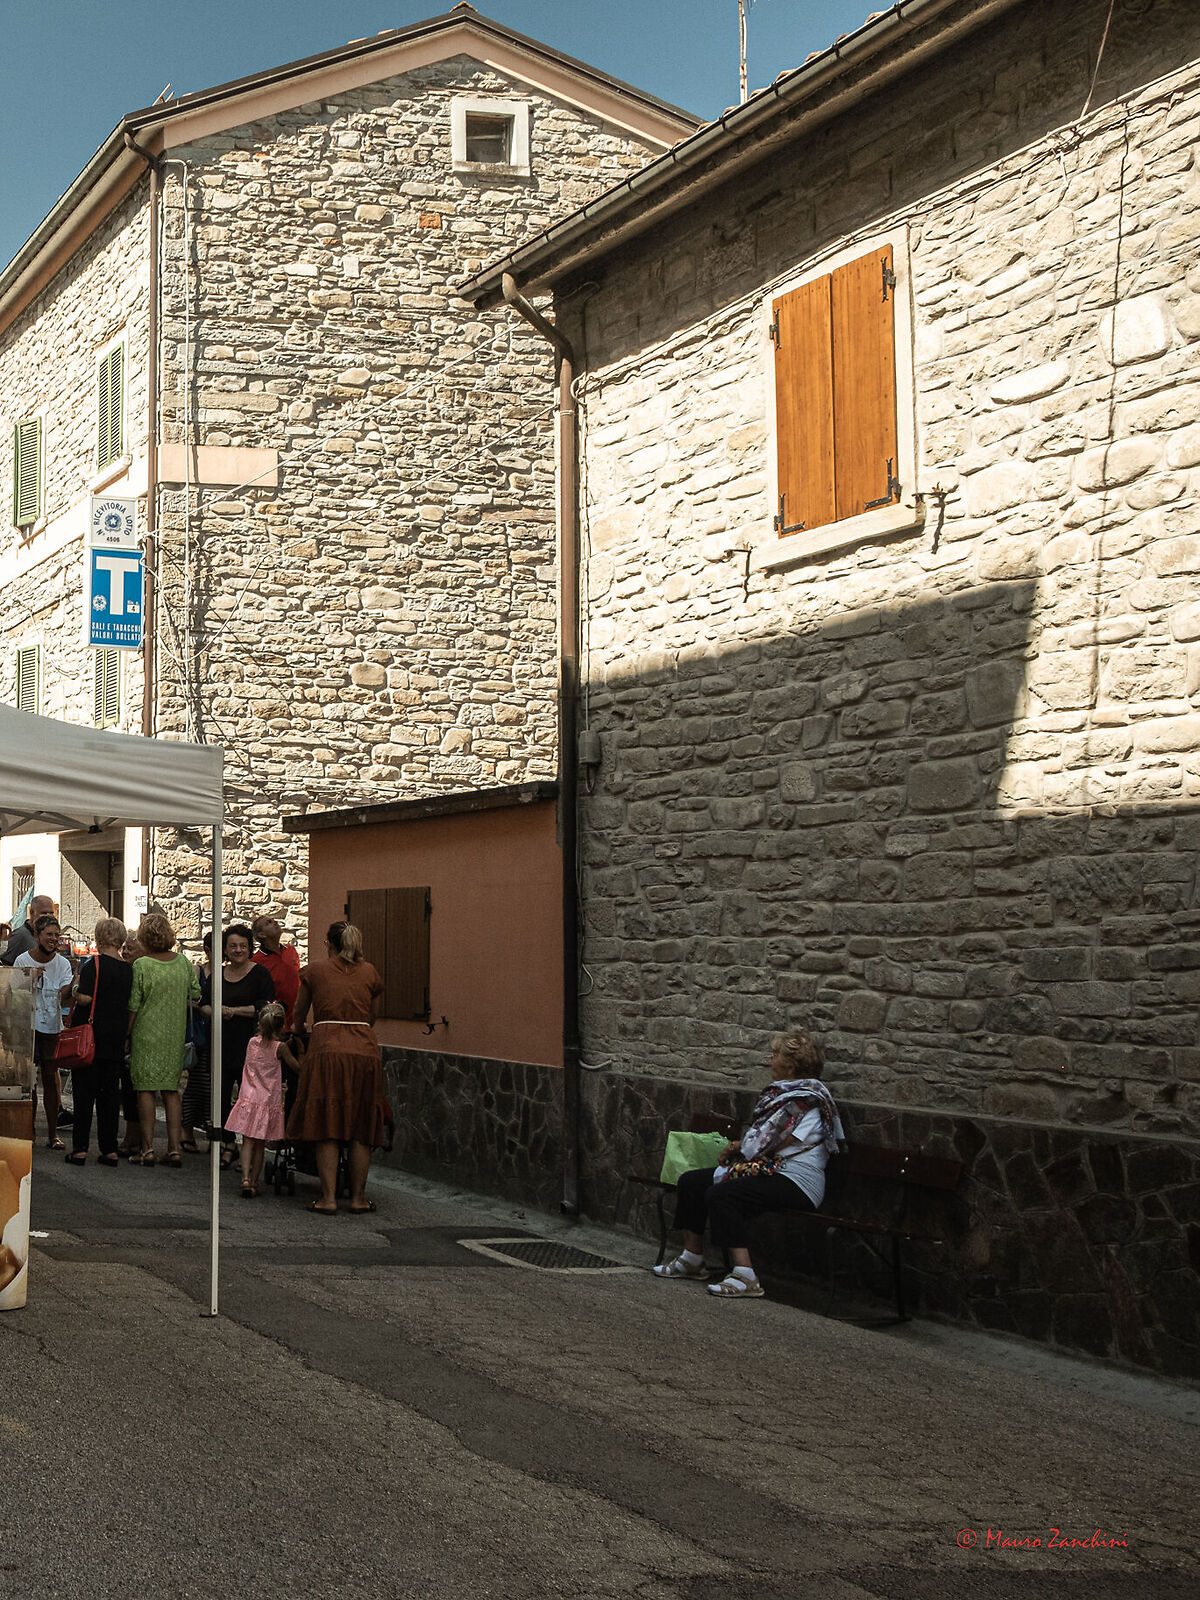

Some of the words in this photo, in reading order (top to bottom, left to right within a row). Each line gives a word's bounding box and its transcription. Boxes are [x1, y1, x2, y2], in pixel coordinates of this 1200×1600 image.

[93, 502, 126, 525] RICEVITORIA
[123, 515, 133, 536] LOTTO
[96, 556, 139, 616] T
[91, 622, 105, 630] SALI
[113, 624, 141, 632] TABACCHI
[91, 631, 113, 639] VALORI
[116, 632, 141, 641] BOLLATI
